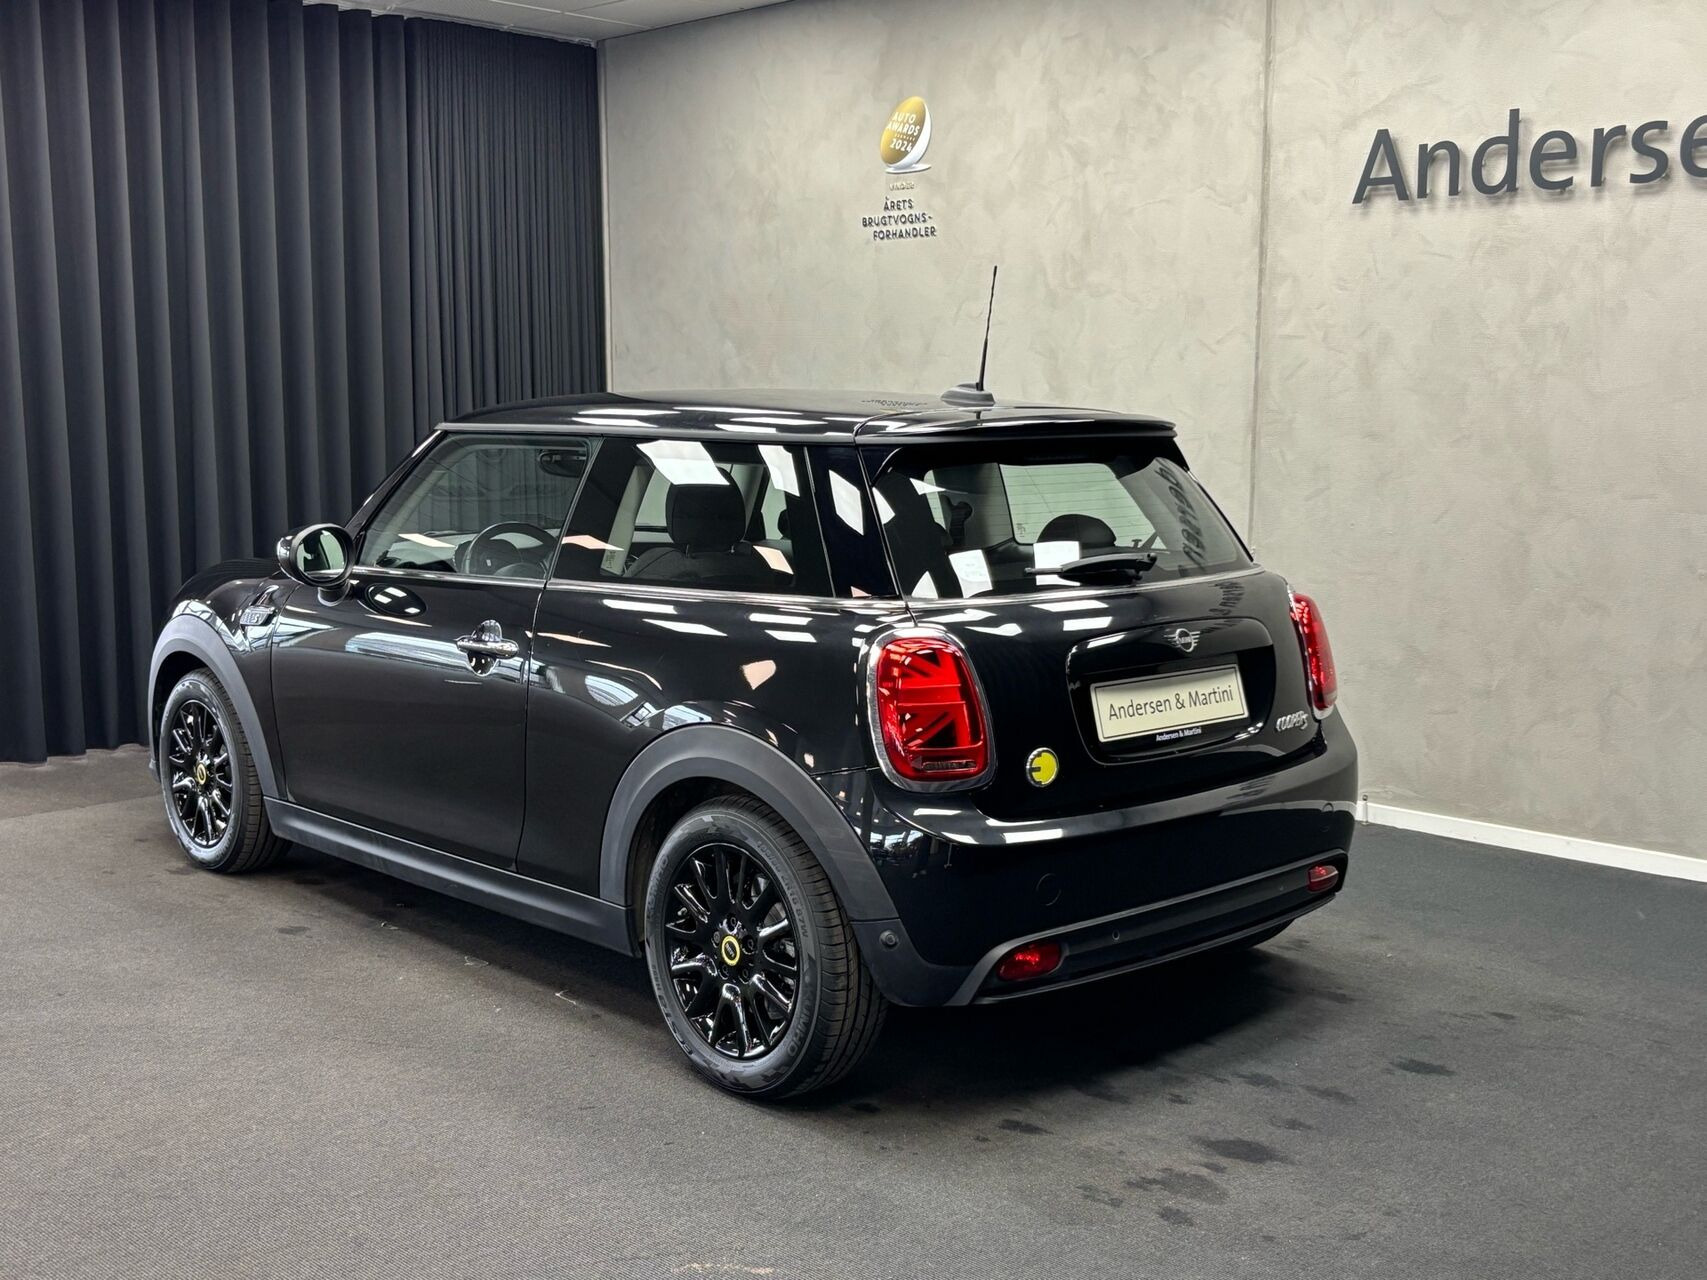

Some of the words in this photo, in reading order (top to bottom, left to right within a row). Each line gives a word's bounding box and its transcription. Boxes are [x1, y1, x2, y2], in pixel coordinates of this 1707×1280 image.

[892, 111, 916, 124] AUTO
[886, 121, 920, 136] AWARDS
[890, 138, 912, 153] 2024
[884, 196, 914, 211] ÅRETS
[862, 212, 933, 228] BRUGTVOGNS-
[873, 226, 937, 240] FORHANDLER
[1109, 699, 1172, 720] Andersen
[1174, 693, 1186, 710] &
[1188, 685, 1234, 708] Martini
